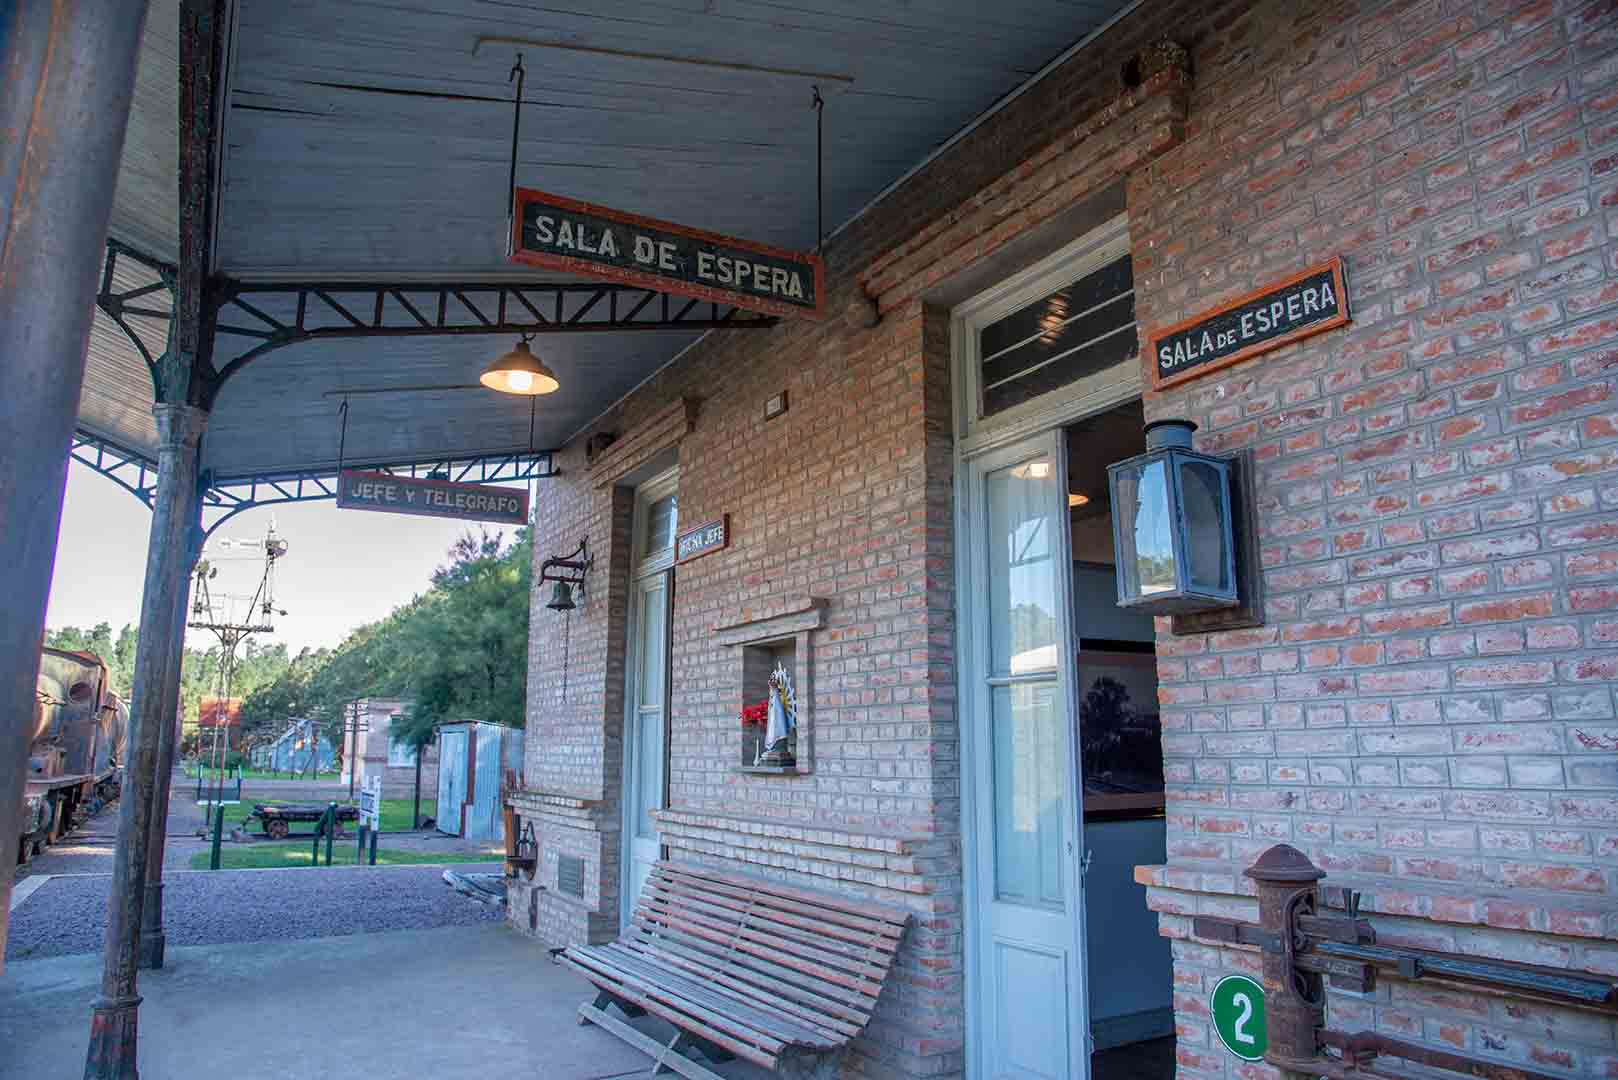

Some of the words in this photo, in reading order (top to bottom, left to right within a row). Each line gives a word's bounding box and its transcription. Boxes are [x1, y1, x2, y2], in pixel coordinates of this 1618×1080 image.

[535, 215, 617, 257] SALA
[632, 235, 678, 271] DE
[697, 251, 803, 299] ESPERA
[1160, 331, 1215, 369] SALA
[1217, 329, 1236, 349] DE
[1241, 282, 1336, 339] ESPERA
[352, 483, 396, 501] JEFE
[406, 490, 416, 503] Y
[424, 489, 518, 513] TELEGRAFO
[1233, 993, 1255, 1044] 2
